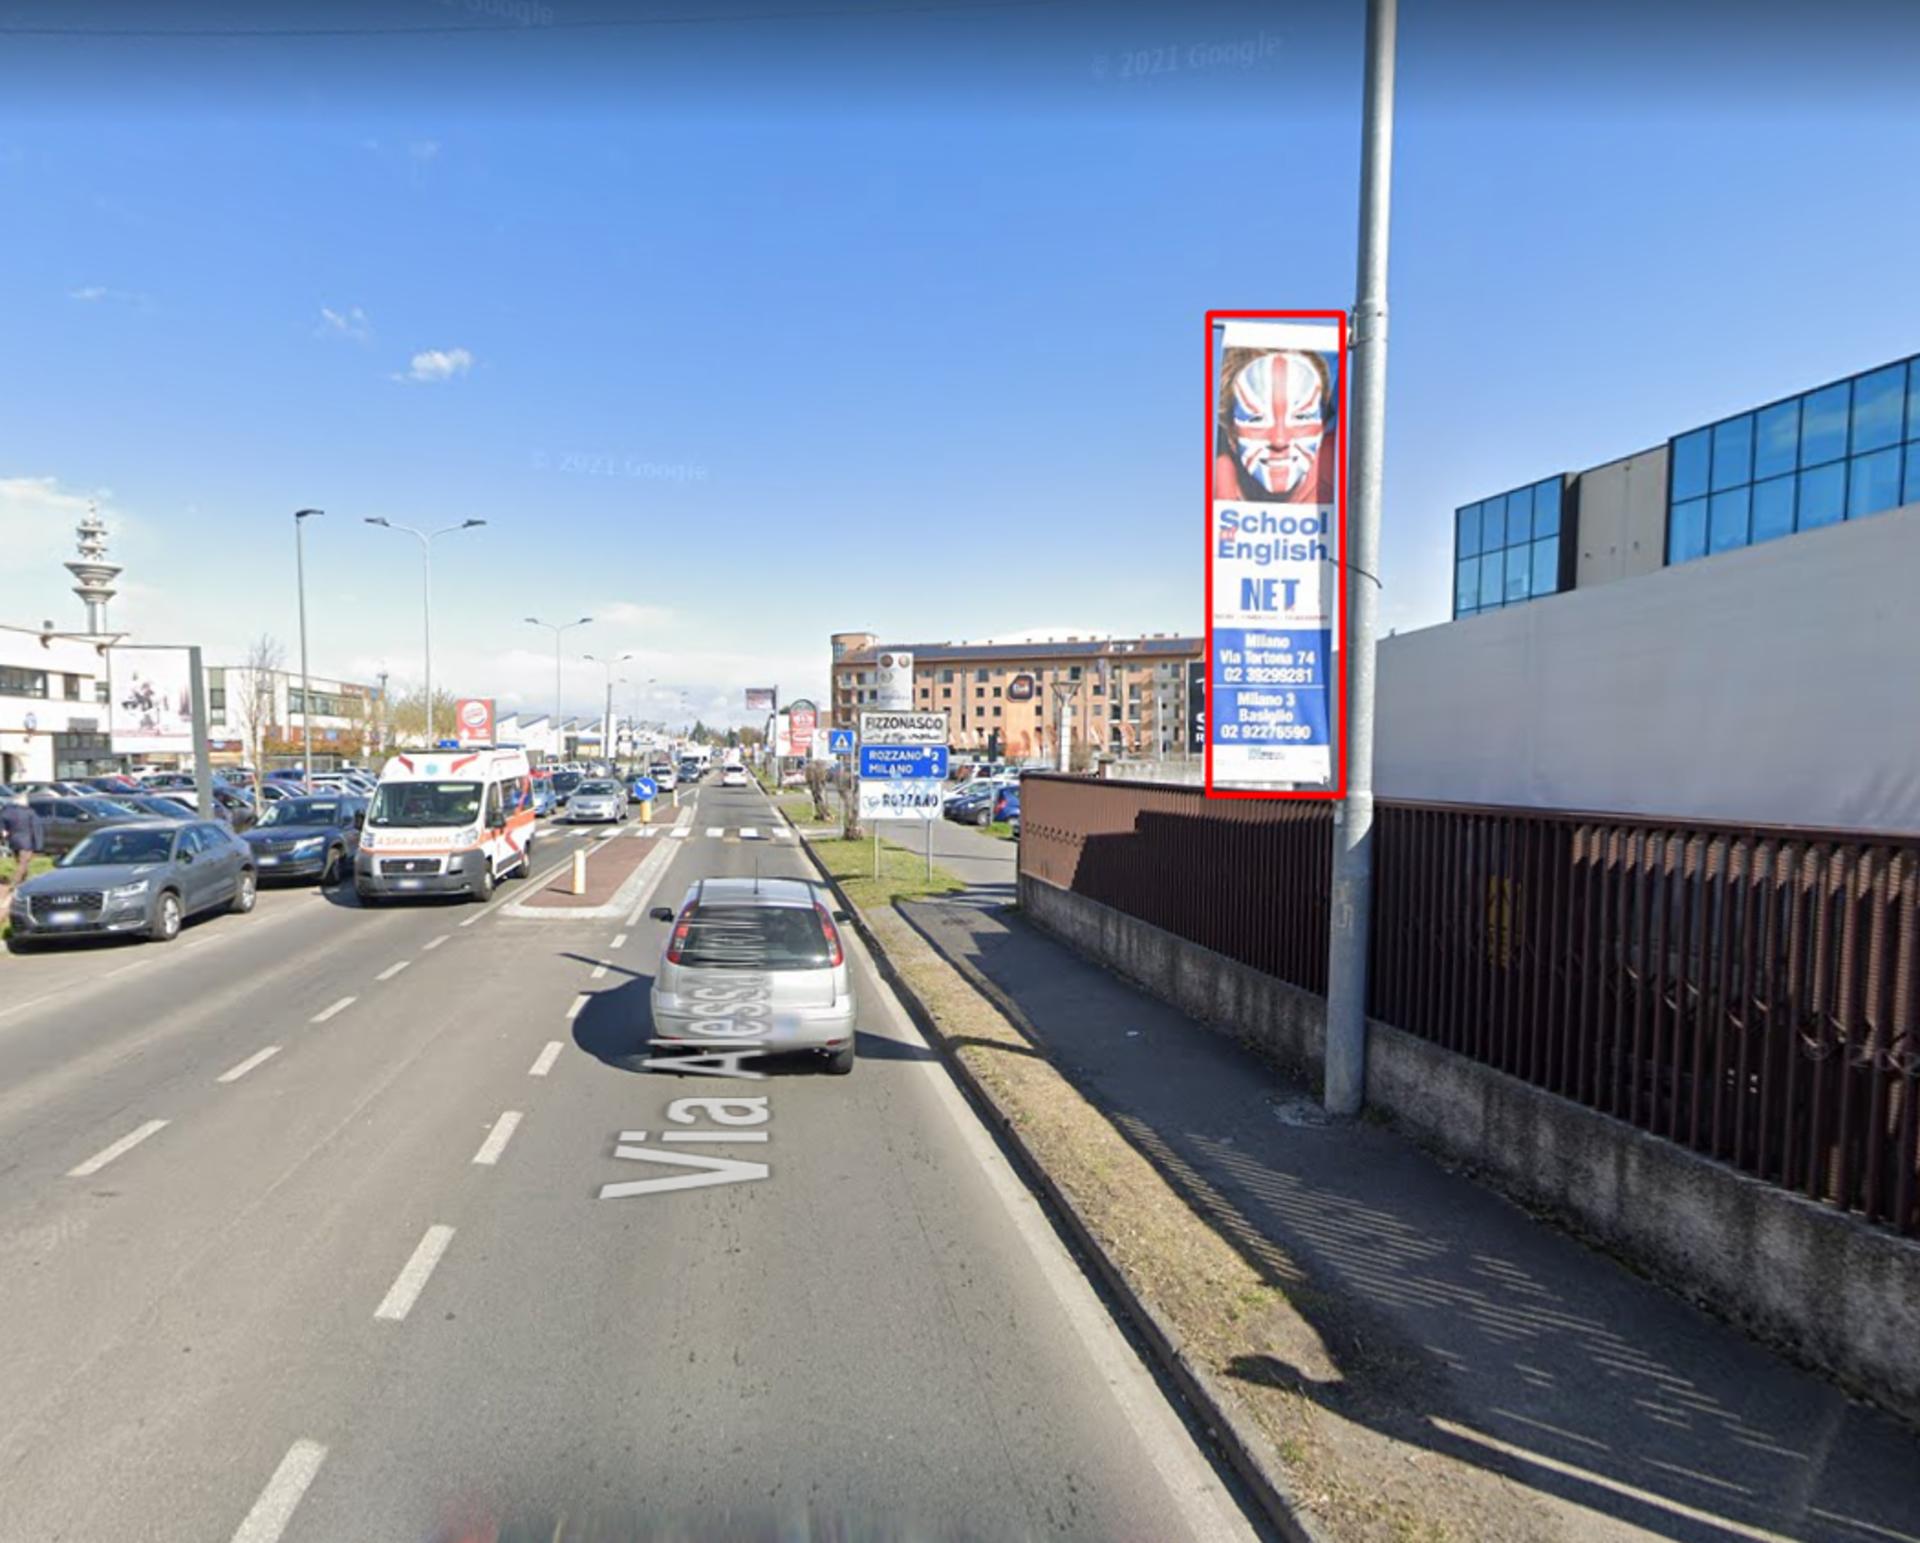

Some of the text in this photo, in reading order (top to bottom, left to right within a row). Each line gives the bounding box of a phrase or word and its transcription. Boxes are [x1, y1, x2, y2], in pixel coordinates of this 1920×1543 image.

[1219, 509, 1328, 535] School
[1218, 539, 1328, 566] English
[1240, 578, 1300, 611] NET
[1244, 633, 1290, 648] Milano
[1220, 649, 1241, 664] Via
[1297, 651, 1315, 665] 74
[1224, 667, 1242, 682] 02
[1237, 691, 1296, 707] Milano 3
[1220, 724, 1239, 738] 02
[868, 750, 923, 761] ROZZANO
[868, 764, 914, 774] MILANO
[881, 793, 938, 808] ROZZANO
